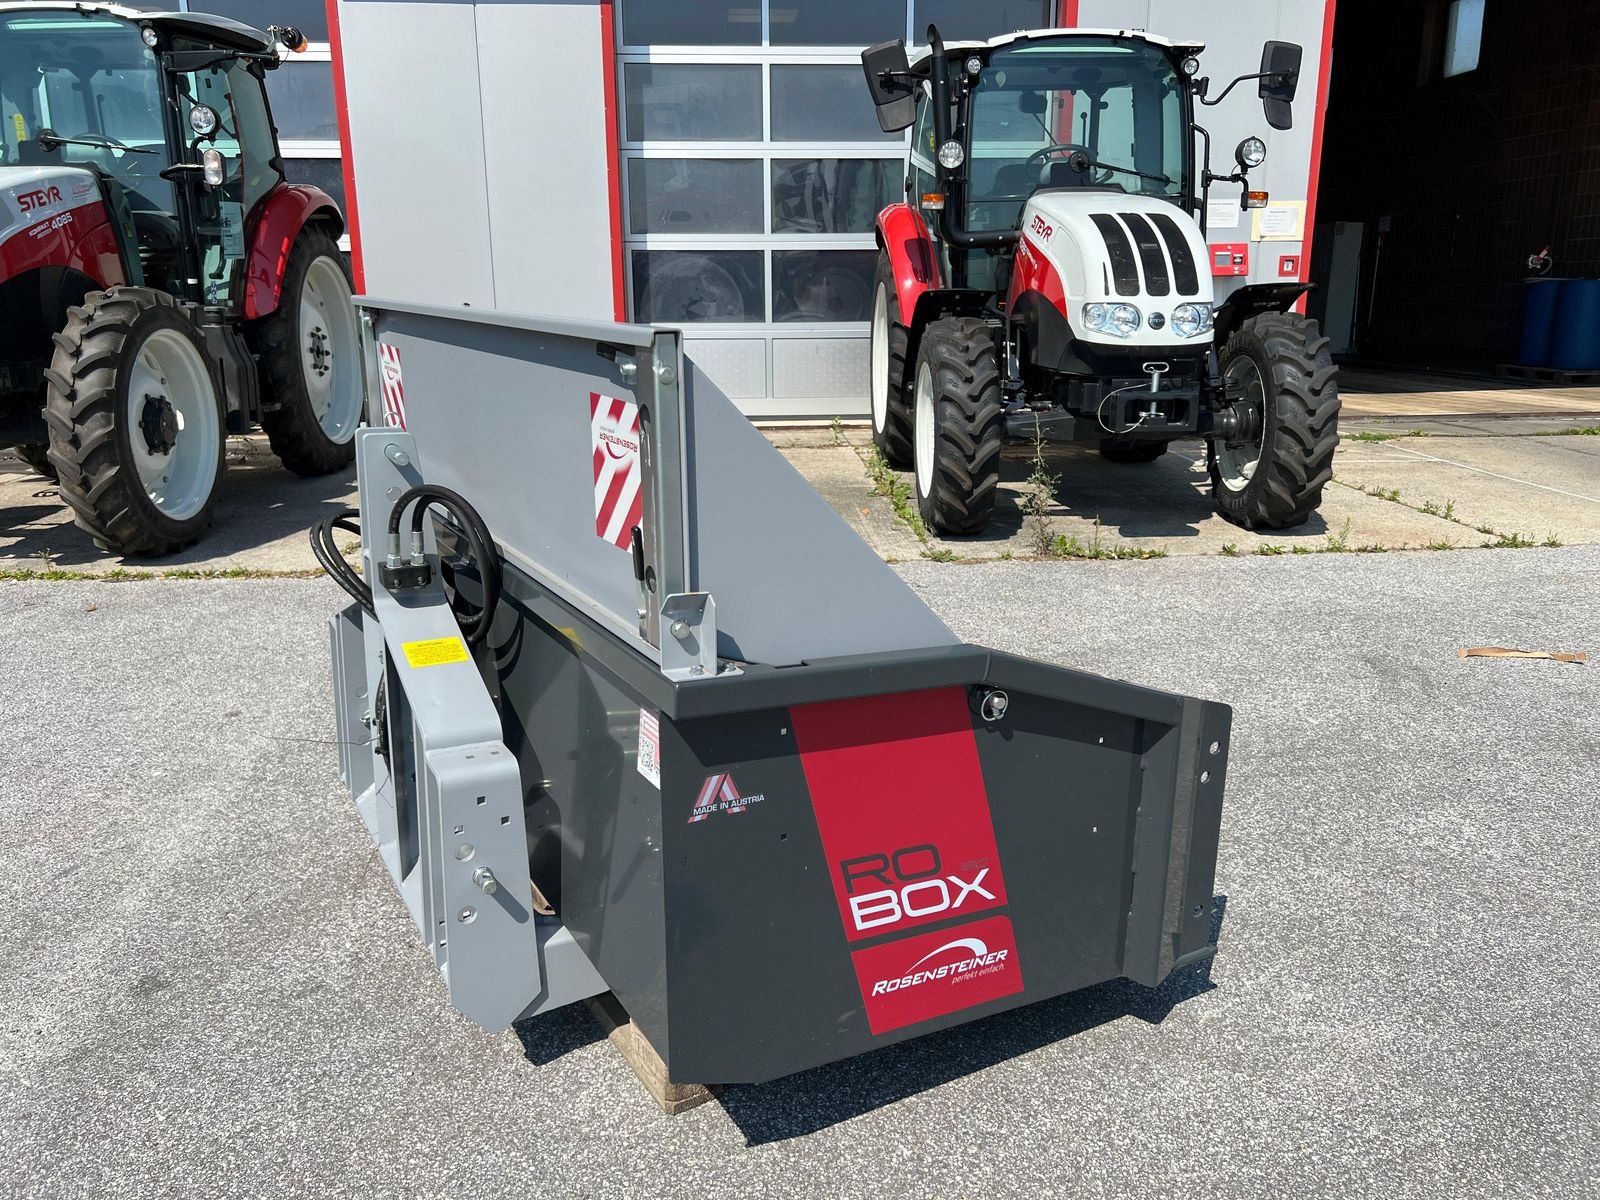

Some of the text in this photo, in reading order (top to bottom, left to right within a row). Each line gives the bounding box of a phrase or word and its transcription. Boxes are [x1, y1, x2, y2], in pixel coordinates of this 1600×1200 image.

[17, 186, 63, 213] STEYR
[51, 212, 73, 230] 4085
[1031, 214, 1053, 242] STEYR
[599, 432, 639, 453] ROSENSTEINER
[693, 794, 765, 816] MADE IN AUSTRIA
[840, 843, 941, 894] RO
[849, 867, 997, 931] BOX
[871, 949, 1008, 997] ROSENSTEINER
[951, 970, 978, 985] perfekt
